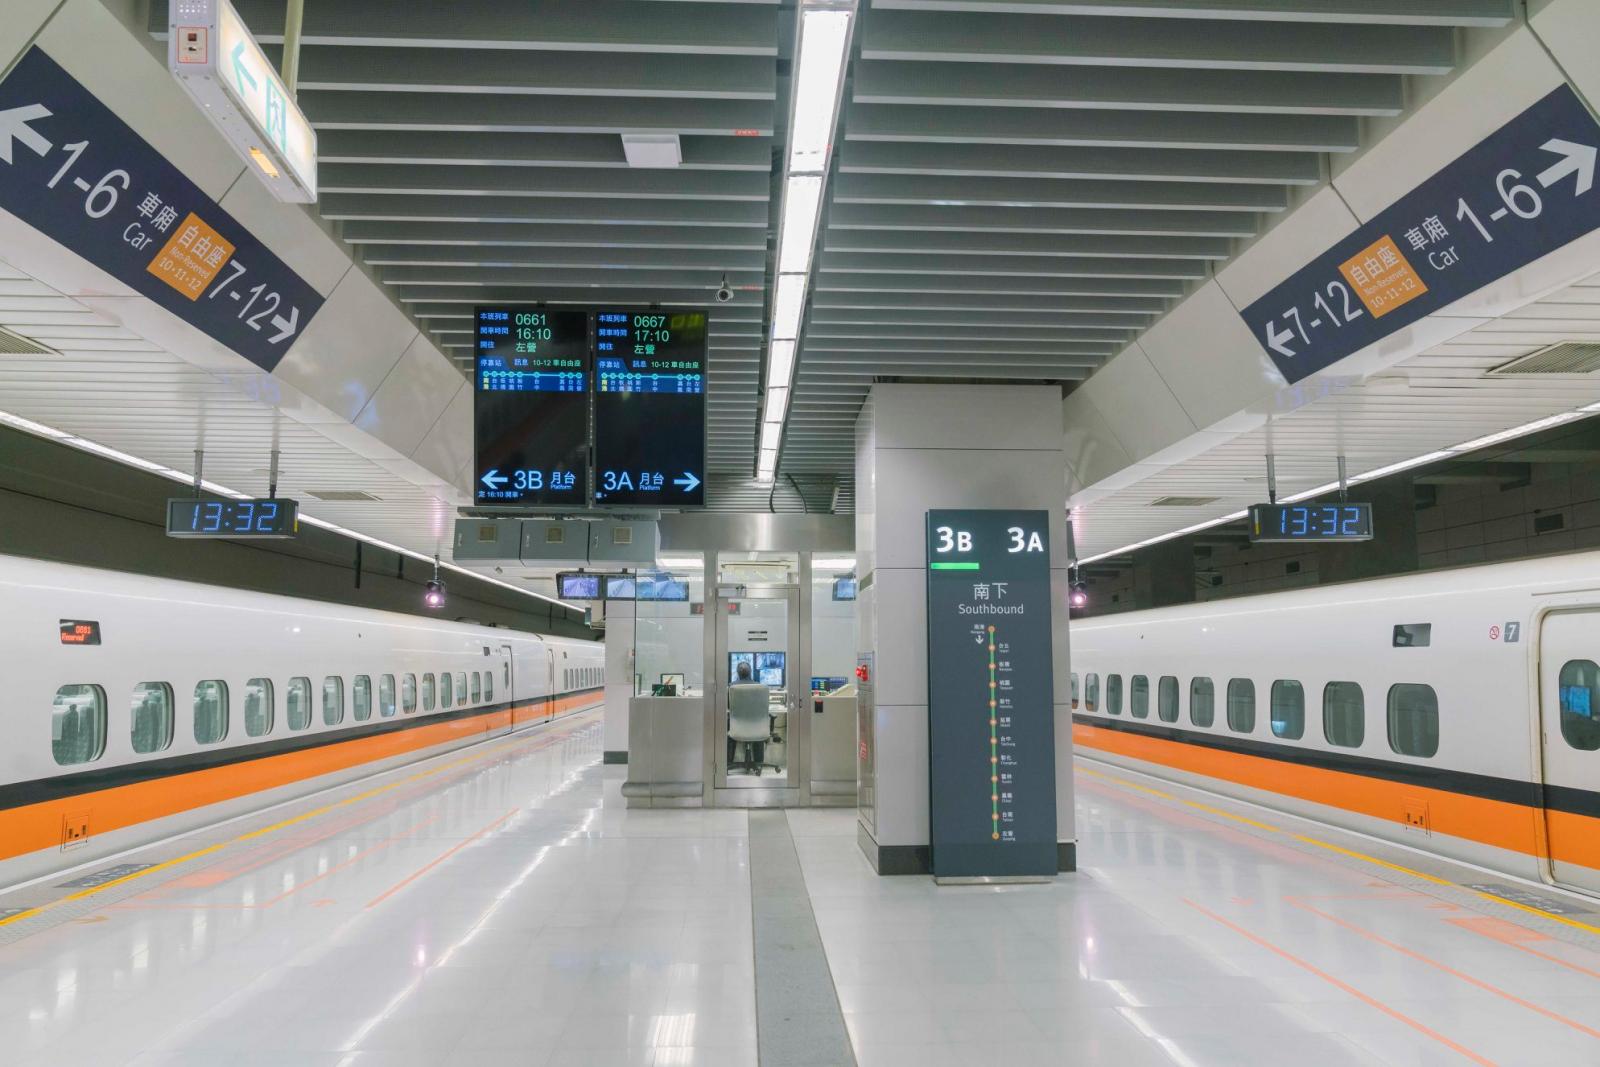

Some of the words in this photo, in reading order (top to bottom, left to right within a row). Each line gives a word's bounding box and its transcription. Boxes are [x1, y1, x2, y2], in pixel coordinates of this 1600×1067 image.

[47, 140, 130, 219] 1-6
[136, 191, 178, 233] 車廂
[1456, 168, 1543, 243] 1-6
[123, 222, 154, 252] Car
[1403, 214, 1449, 251] 車廂
[177, 225, 226, 268] 自由座
[1428, 245, 1460, 271] Car
[1350, 245, 1400, 287] 自由座
[208, 259, 281, 331] 7-12
[515, 313, 547, 326] 0661
[634, 315, 666, 328] 0667
[1282, 280, 1364, 345] 7-12
[516, 328, 551, 340] 16:10
[634, 330, 670, 342] 17:10
[513, 470, 543, 490] 3B
[551, 471, 577, 485] 月台
[603, 471, 634, 491] 3A
[639, 472, 665, 486] 月台
[192, 503, 278, 531] 13:32
[1281, 508, 1360, 535] 13:32
[936, 526, 973, 553] 3B
[1007, 526, 1045, 553] 3A
[973, 582, 1009, 600] 南下
[958, 603, 1024, 615] Southbound
[1508, 624, 1517, 641] 7
